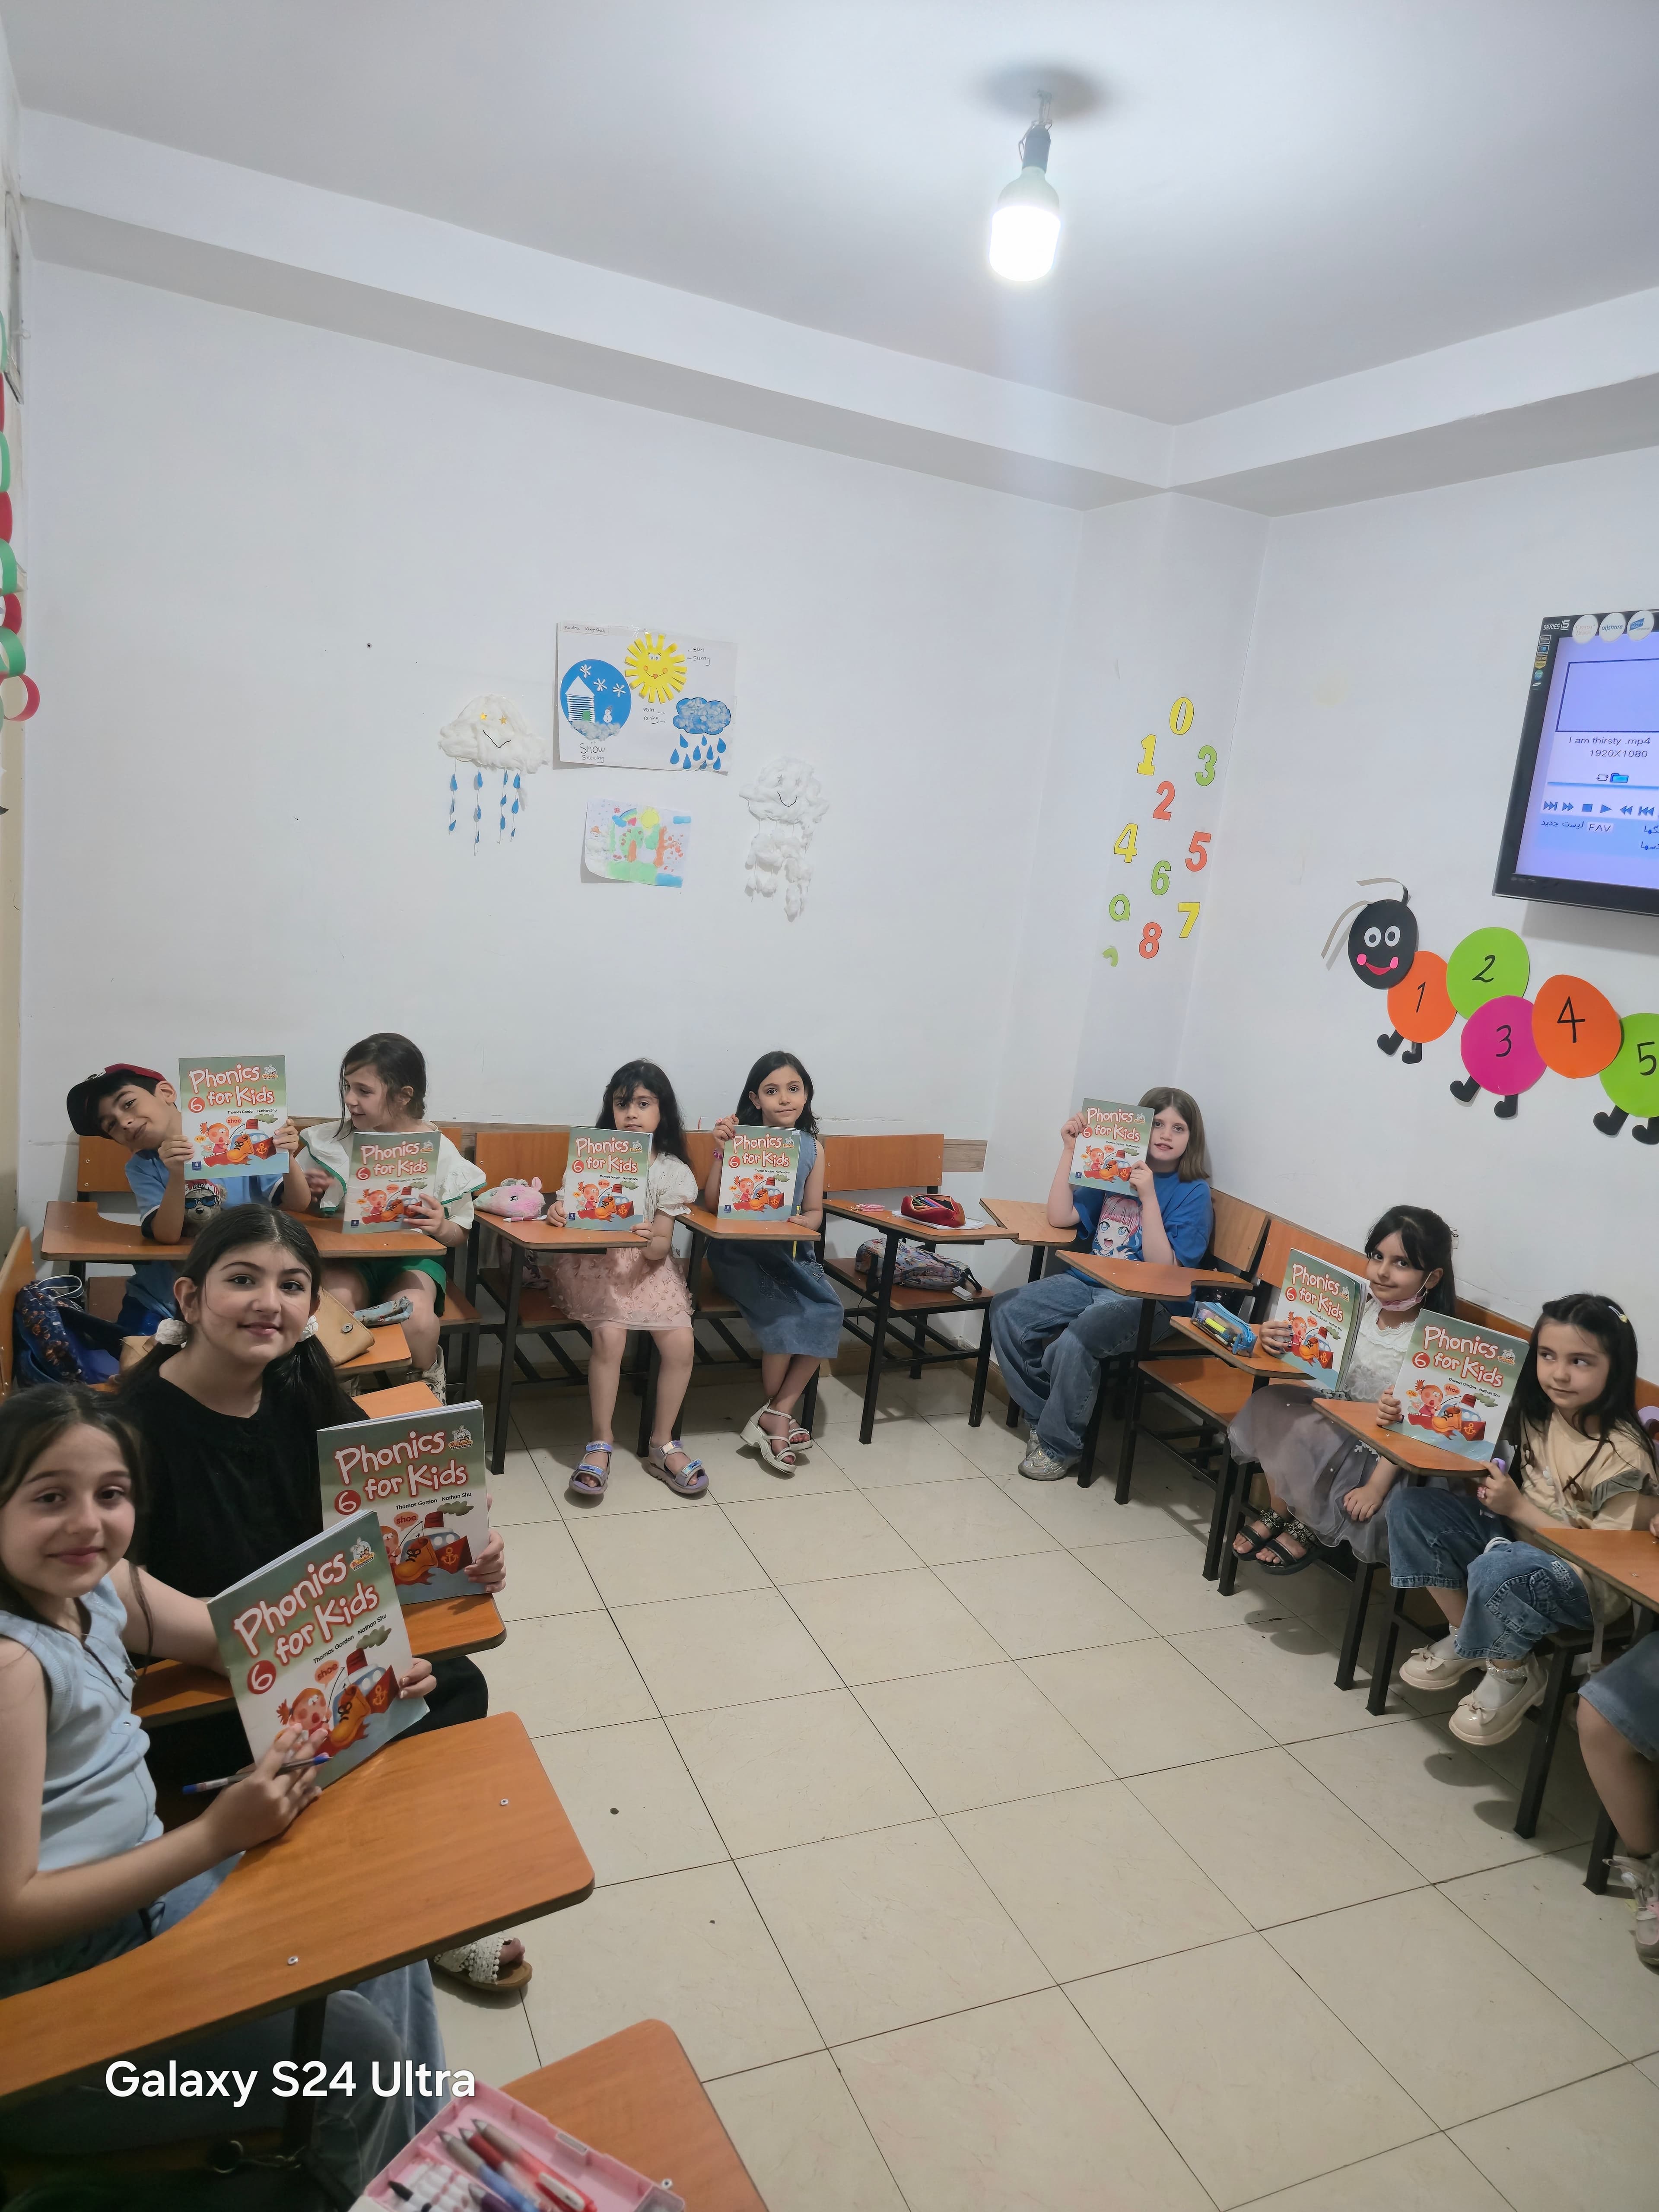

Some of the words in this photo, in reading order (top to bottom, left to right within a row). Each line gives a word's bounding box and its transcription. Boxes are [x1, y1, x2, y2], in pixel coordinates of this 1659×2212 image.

[1562, 620, 1570, 629] 5
[1170, 697, 1194, 734] 0
[1137, 734, 1157, 775] 1
[1592, 737, 1621, 746] thirsty
[1625, 737, 1650, 746] .mp4
[1195, 745, 1217, 786] 3
[1153, 781, 1175, 820] 2
[1589, 824, 1611, 832] FAV
[1114, 823, 1138, 863] 4
[1185, 831, 1211, 871] 5
[1150, 860, 1171, 895] 6
[1178, 902, 1200, 938] 7
[1139, 922, 1162, 959] 8
[1472, 955, 1496, 983] 2
[1416, 982, 1426, 1013] 1
[1557, 996, 1586, 1043] 4
[1496, 1025, 1512, 1057] 3
[1637, 1041, 1657, 1076] 5
[189, 1064, 260, 1093] Phonics
[191, 1098, 202, 1111] 6
[207, 1091, 232, 1105] for
[236, 1086, 274, 1106] Kids
[1087, 1107, 1134, 1124] Phonics
[733, 1134, 782, 1154] Phonics
[1083, 1127, 1090, 1137] 6
[1095, 1124, 1111, 1135] for
[1113, 1124, 1140, 1141] Kids
[360, 1141, 420, 1164] Phonics
[576, 1137, 629, 1157] Phonics
[743, 1153, 760, 1164] for
[763, 1150, 789, 1167] Kids
[358, 1168, 368, 1180] 6
[374, 1164, 395, 1175] for
[397, 1158, 427, 1176] Kids
[573, 1160, 582, 1172] 6
[587, 1157, 605, 1169] for
[608, 1155, 637, 1173] Kids
[730, 1157, 738, 1167] 6
[1293, 1263, 1340, 1295] Phonics
[1287, 1287, 1295, 1301] 6
[1300, 1288, 1317, 1305] for
[1318, 1293, 1343, 1322] Kids
[1424, 1325, 1498, 1359] Phonics
[1414, 1353, 1426, 1367] 6
[1434, 1352, 1460, 1370] for
[1461, 1357, 1503, 1387] Kids
[335, 1431, 445, 1484] Phonics
[365, 1477, 402, 1499] for
[408, 1459, 467, 1495] Kids
[338, 1491, 356, 1512] 6
[397, 1516, 417, 1524] shoe
[234, 1553, 346, 1655] Phonics
[275, 1624, 314, 1663] for
[315, 1583, 378, 1640] Kids
[313, 1648, 334, 1664] Thomas
[335, 1635, 354, 1649] Gordon
[358, 1621, 377, 1635] Nathan
[377, 1614, 387, 1622] Shu
[251, 1662, 272, 1691] 6
[318, 1664, 338, 1681] shoe
